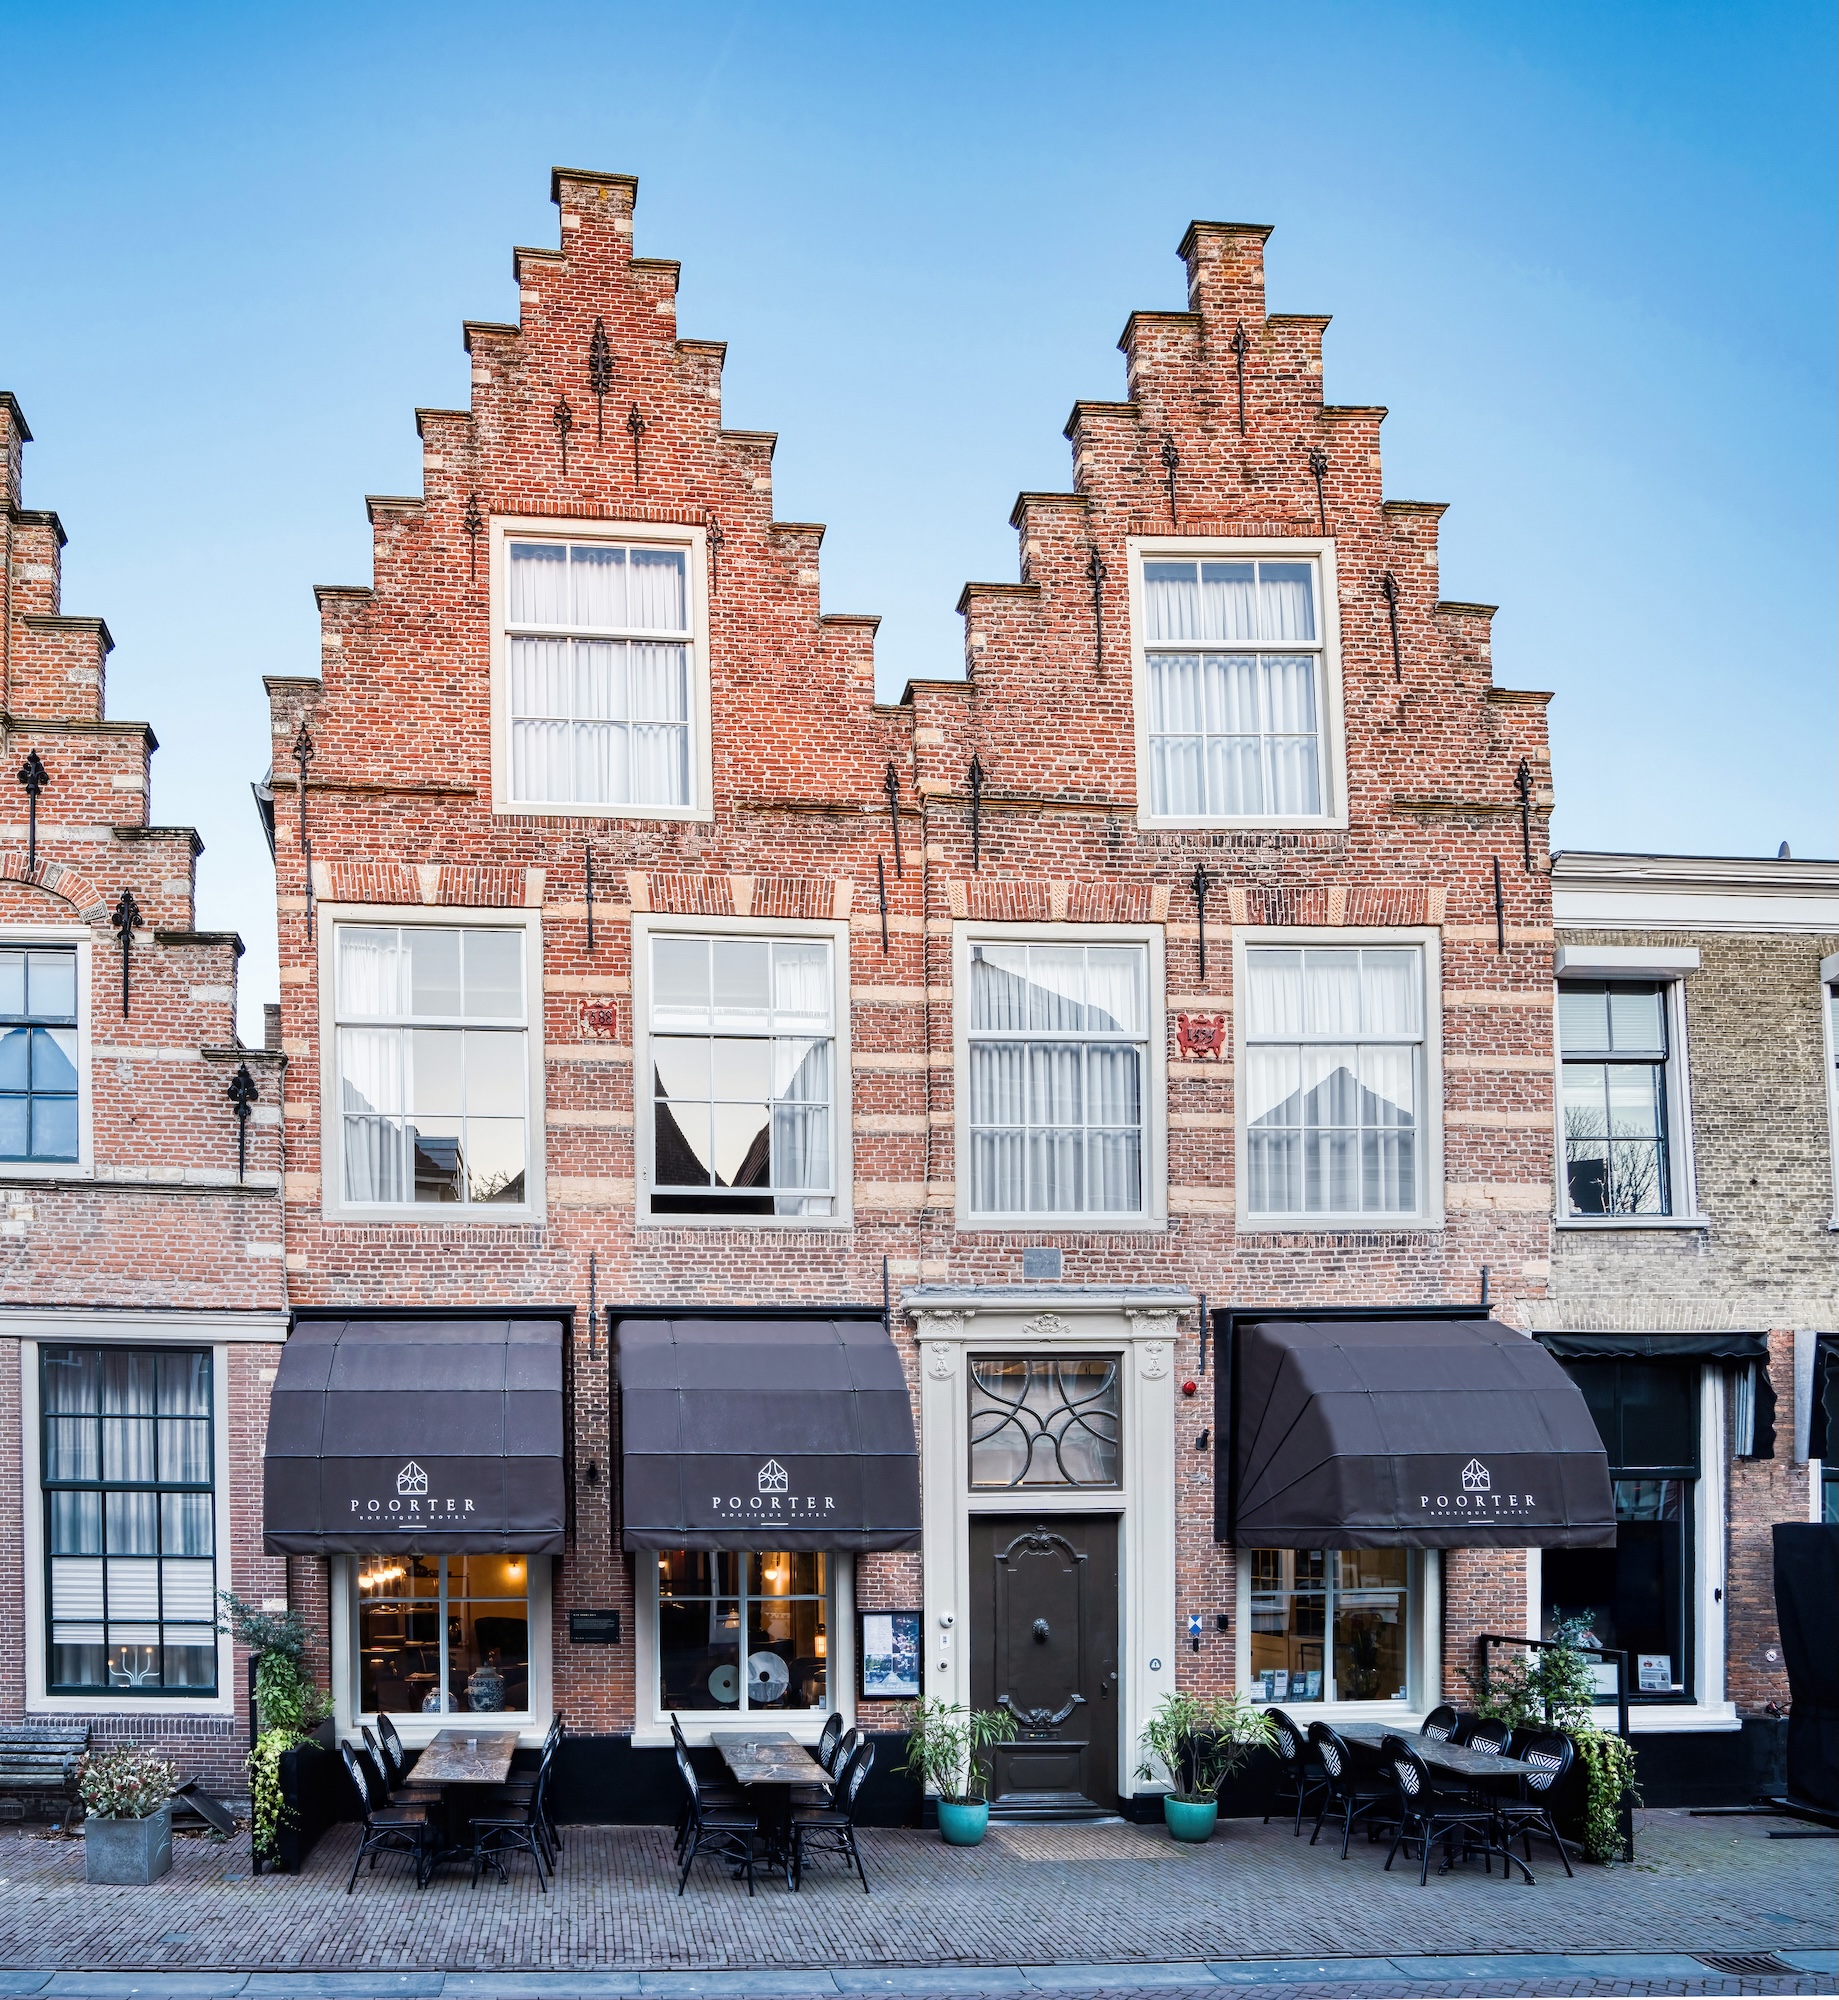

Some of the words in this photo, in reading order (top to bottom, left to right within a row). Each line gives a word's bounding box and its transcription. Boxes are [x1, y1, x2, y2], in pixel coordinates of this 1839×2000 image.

[351, 1499, 475, 1511] POORTER
[712, 1497, 835, 1508] POORTER
[1421, 1495, 1535, 1507] POORTER
